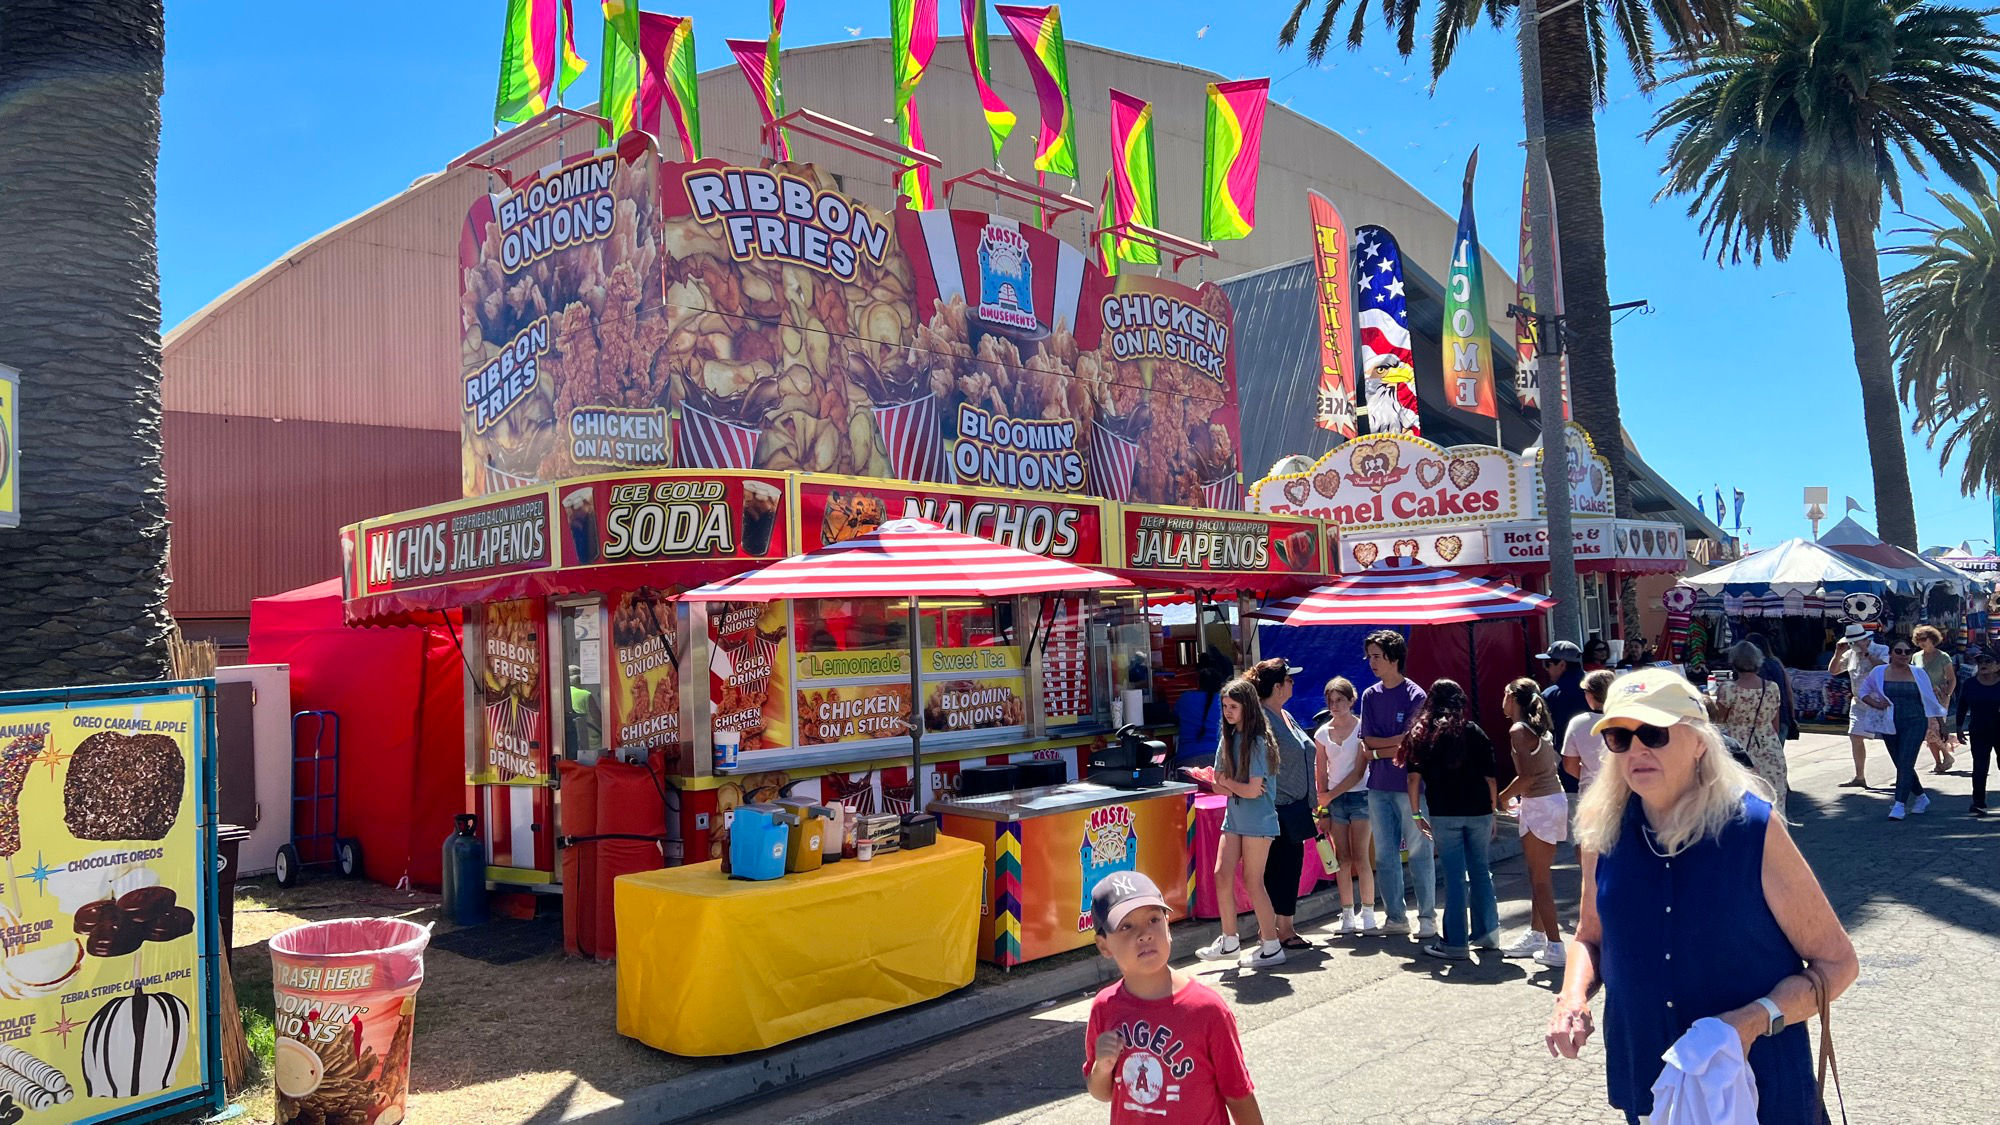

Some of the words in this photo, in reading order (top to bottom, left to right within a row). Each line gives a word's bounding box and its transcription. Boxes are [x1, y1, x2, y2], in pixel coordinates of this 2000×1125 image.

[500, 159, 614, 231] BLOOMIN'
[688, 173, 887, 260] RIBBON
[502, 196, 613, 267] ONIONS
[986, 226, 1023, 250] KASTL
[728, 216, 855, 277] FRIES
[980, 306, 1036, 329] AMUSEMENTS
[1103, 296, 1226, 353] CHICKEN
[466, 322, 546, 405] RIBBON
[1113, 330, 1143, 356] ON
[1148, 330, 1162, 353] A
[1165, 333, 1223, 378] STICK
[477, 359, 536, 428] FRIES
[571, 412, 663, 439] CHICKEN
[961, 409, 1073, 450] BLOOMIN'
[574, 440, 597, 457] ON
[600, 441, 613, 458] A
[615, 442, 665, 462] STICK
[956, 442, 1083, 487] ONIONS
[611, 484, 650, 503] ICE
[655, 482, 723, 500] COLD
[1391, 487, 1500, 520] Cakes
[1578, 494, 1607, 513] Cakes
[452, 516, 467, 532] DEEP
[468, 513, 486, 529] FRIED
[487, 508, 508, 525] BACON
[509, 500, 543, 521] WRAPPED
[1140, 516, 1165, 527] DEEP
[1167, 518, 1194, 529] FRIED
[1196, 520, 1225, 531] BACON
[1228, 522, 1269, 534] WRAPPED
[604, 503, 732, 555] SODA
[1504, 532, 1532, 544] Hot
[1535, 529, 1583, 543] Cee
[1587, 528, 1600, 540] &
[370, 522, 447, 585] NACHOS
[451, 518, 544, 570] JALAPENOS
[1132, 530, 1269, 568] JALAPENOS
[1508, 545, 1544, 558] Cold
[712, 607, 760, 626] BOOMIN'
[487, 639, 535, 665] RIBBON
[625, 650, 671, 678] ONIONS
[735, 655, 765, 673] COLD
[810, 653, 900, 676] Lemonade
[933, 650, 978, 670] Sweet
[981, 649, 1005, 668] Tea
[493, 658, 529, 683] FRIES
[729, 666, 771, 687] DRINKS
[819, 694, 900, 721] CHICKEN
[941, 687, 1011, 711] BLOOMIN'
[73, 716, 103, 729] OREO
[104, 717, 152, 731] CARAMEL
[154, 721, 187, 733] APPLE
[621, 712, 678, 741] CHICKEN
[715, 708, 761, 728] CHICKEN
[737, 718, 761, 732] STICK
[819, 724, 841, 738] ON
[844, 722, 855, 736] A
[858, 716, 900, 733] STICK
[948, 704, 1003, 728] ONIONS
[495, 730, 529, 756] COLD
[648, 731, 679, 749] STICK
[489, 749, 537, 778] DRINKS
[1090, 806, 1130, 830] KASTL
[68, 853, 128, 872] CHOCOLATE
[129, 847, 164, 862] OREOS
[6, 923, 32, 938] SLICE
[34, 919, 53, 931] OUR
[60, 989, 90, 1004] ZEBRA
[91, 983, 122, 997] STRIPE
[123, 974, 163, 990] CARAMEL
[164, 968, 191, 982] APPLE
[277, 965, 322, 990] TRASH
[323, 965, 374, 990] HERE
[1117, 1020, 1195, 1080] NGELS
